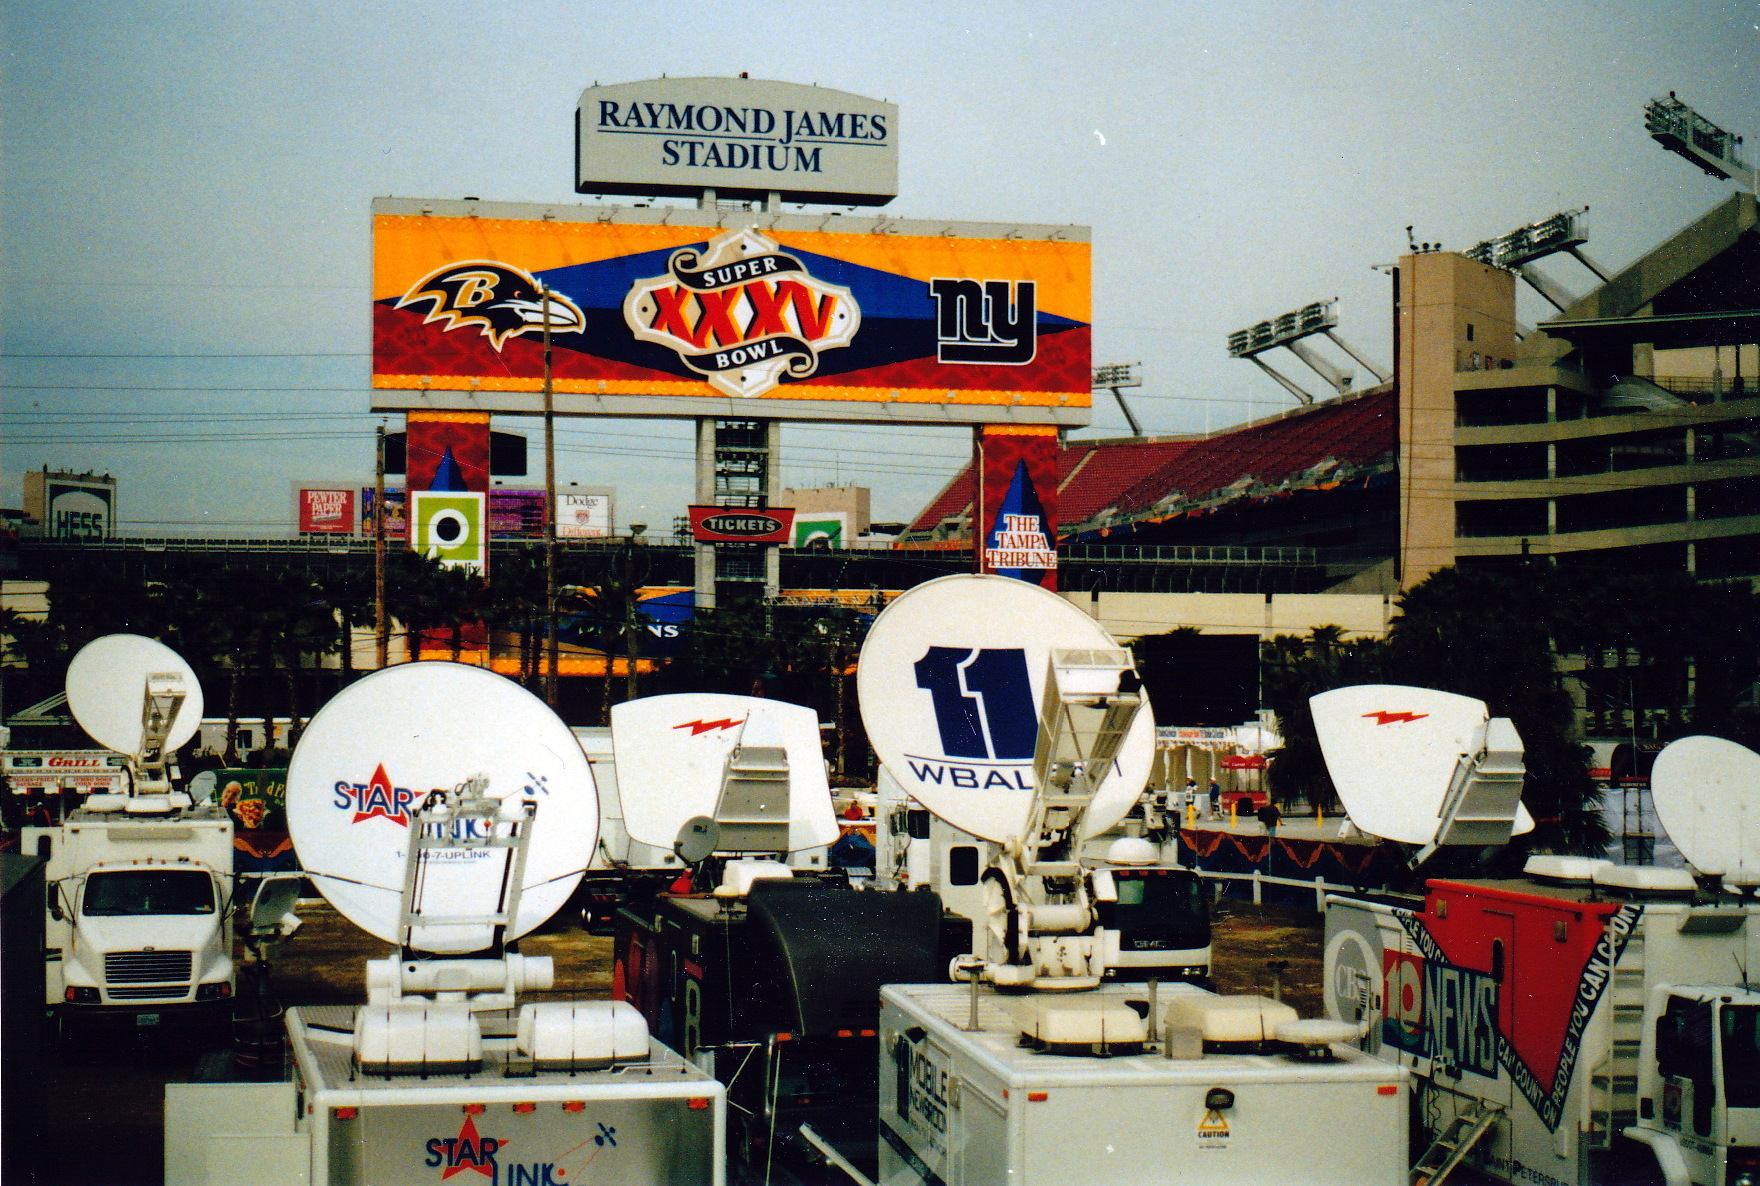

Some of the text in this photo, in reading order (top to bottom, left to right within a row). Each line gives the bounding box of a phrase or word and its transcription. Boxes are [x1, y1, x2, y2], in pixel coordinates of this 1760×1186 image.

[598, 100, 888, 144] RAYMOND JAMES
[662, 139, 822, 173] STADIUM
[702, 256, 779, 288] SUPER
[649, 279, 839, 349] XXXV
[715, 339, 784, 369] BOWL
[307, 490, 347, 504] PEWTER
[311, 503, 342, 516] PAPER
[566, 495, 600, 510] Dodge
[57, 510, 103, 538] HESS
[708, 518, 777, 531] TICKETS
[1004, 515, 1039, 532] THE
[996, 532, 1049, 549] TAMPA
[987, 549, 1057, 568] TRIBUNE
[913, 645, 1039, 760] 11
[48, 756, 102, 768] GRILL
[908, 759, 1034, 791] WBAL
[333, 780, 414, 817] STAR
[1579, 956, 1613, 1002] CAN
[1424, 963, 1496, 1071] NEWS
[1569, 997, 1590, 1040] YOU
[1197, 1130, 1230, 1138] CAUTION
[424, 1137, 499, 1168] STAR
